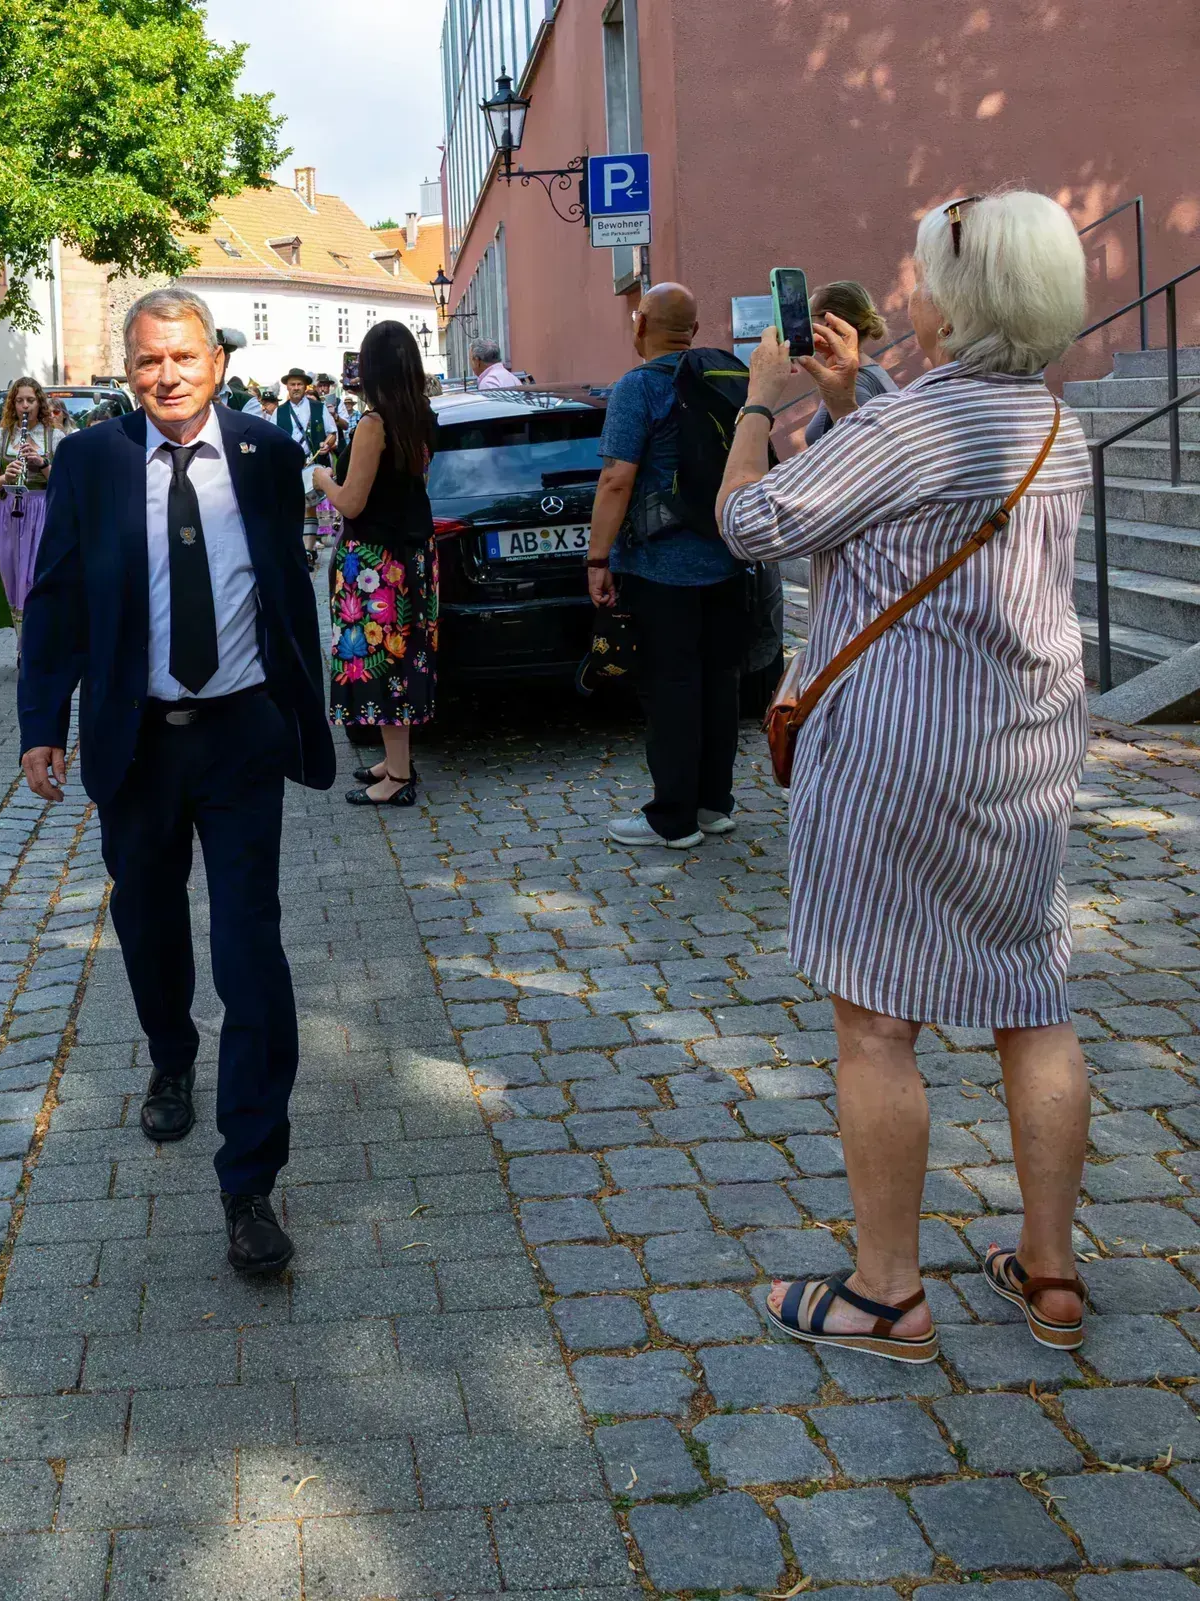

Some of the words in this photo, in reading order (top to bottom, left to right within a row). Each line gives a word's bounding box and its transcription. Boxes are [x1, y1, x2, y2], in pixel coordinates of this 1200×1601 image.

[603, 162, 635, 207] P
[597, 220, 644, 230] Bewohner
[510, 531, 539, 554] AB
[553, 528, 569, 550] X
[572, 526, 591, 548] 3
